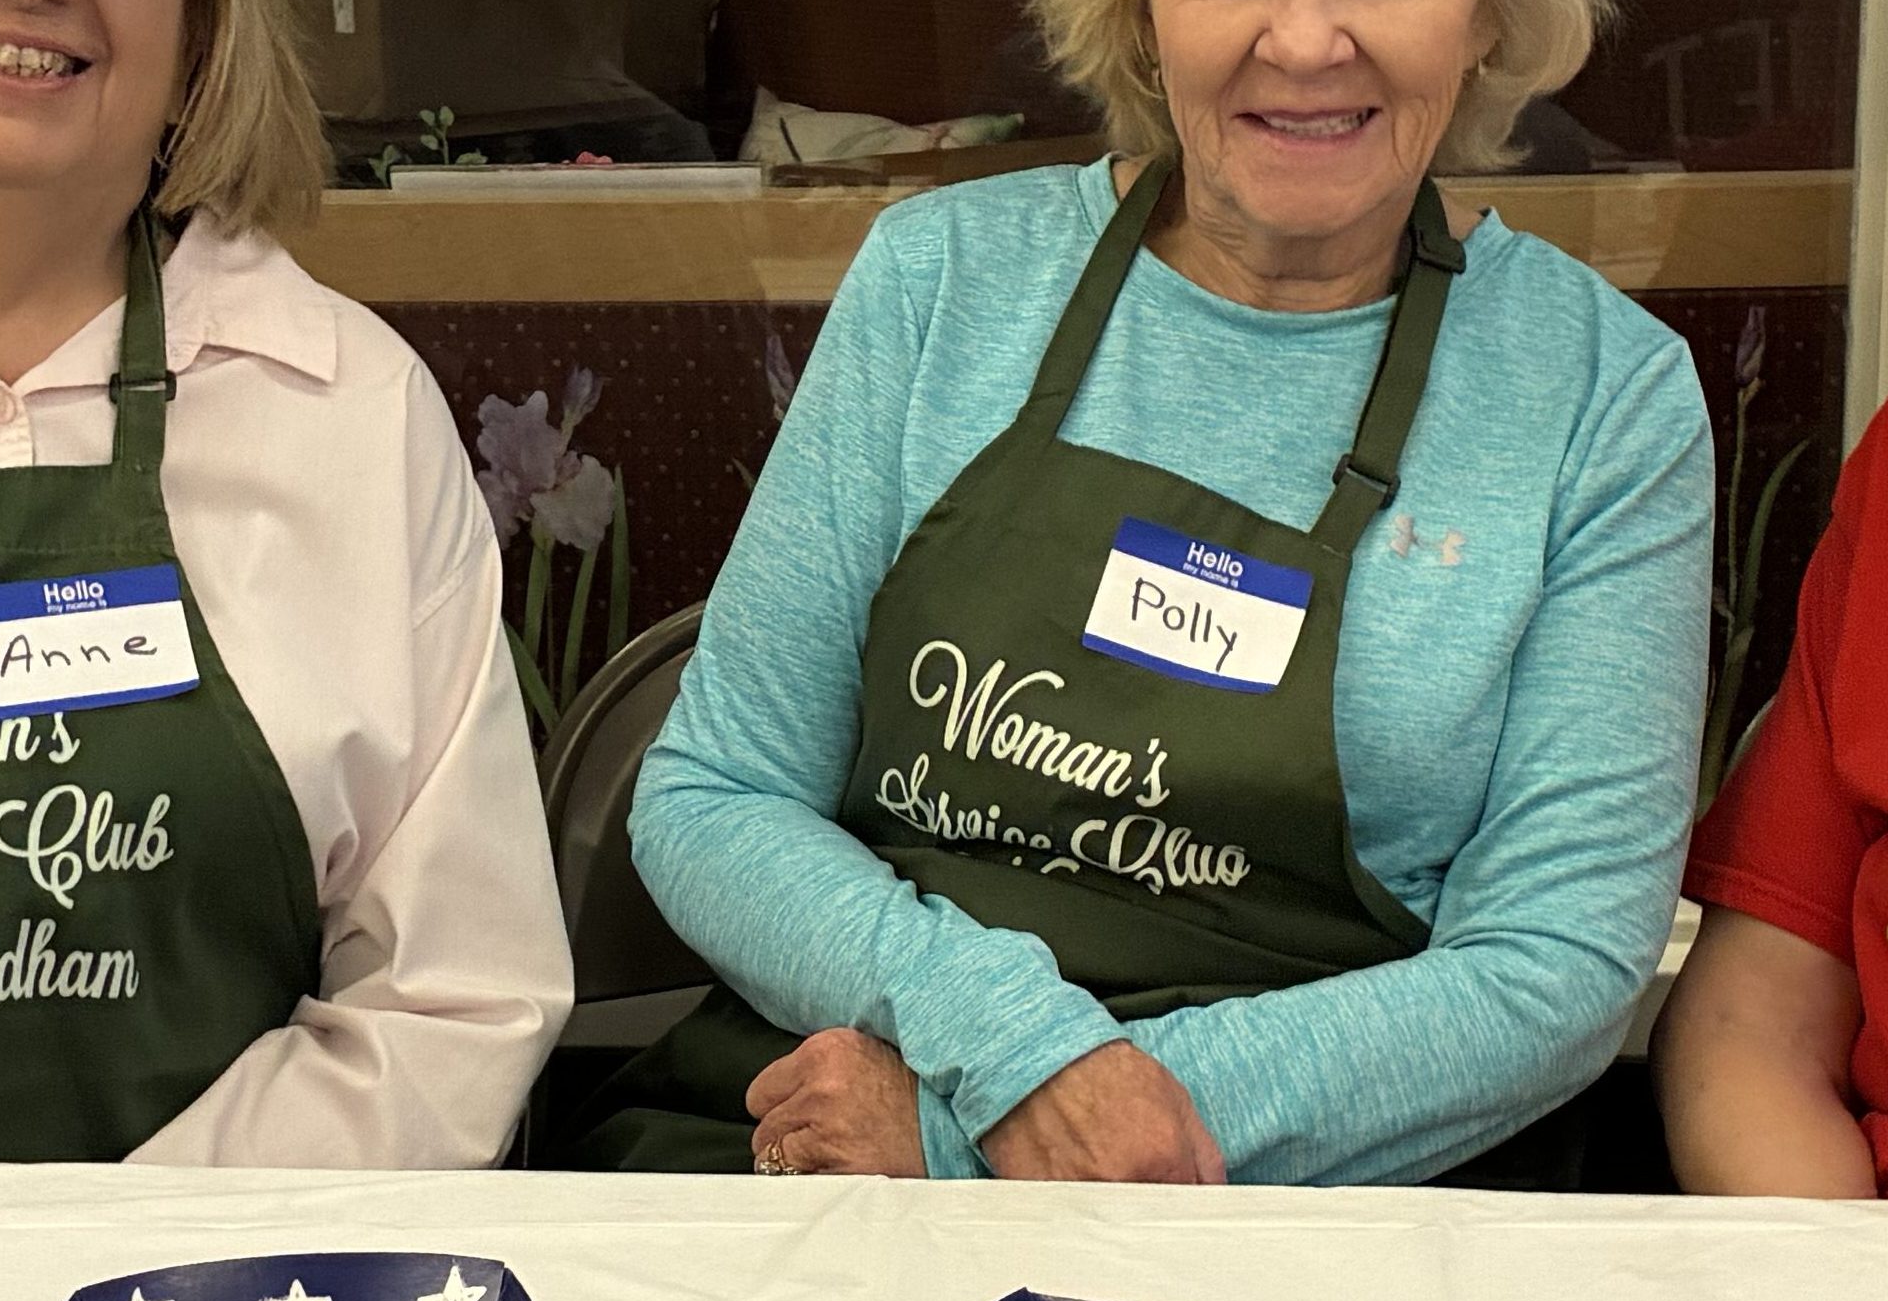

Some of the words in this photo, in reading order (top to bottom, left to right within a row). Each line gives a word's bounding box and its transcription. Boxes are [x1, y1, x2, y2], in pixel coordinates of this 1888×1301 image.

[43, 581, 106, 603] Hello
[1187, 541, 1243, 578] Hello
[1132, 577, 1238, 672] Polly
[908, 640, 1171, 808] Woman's
